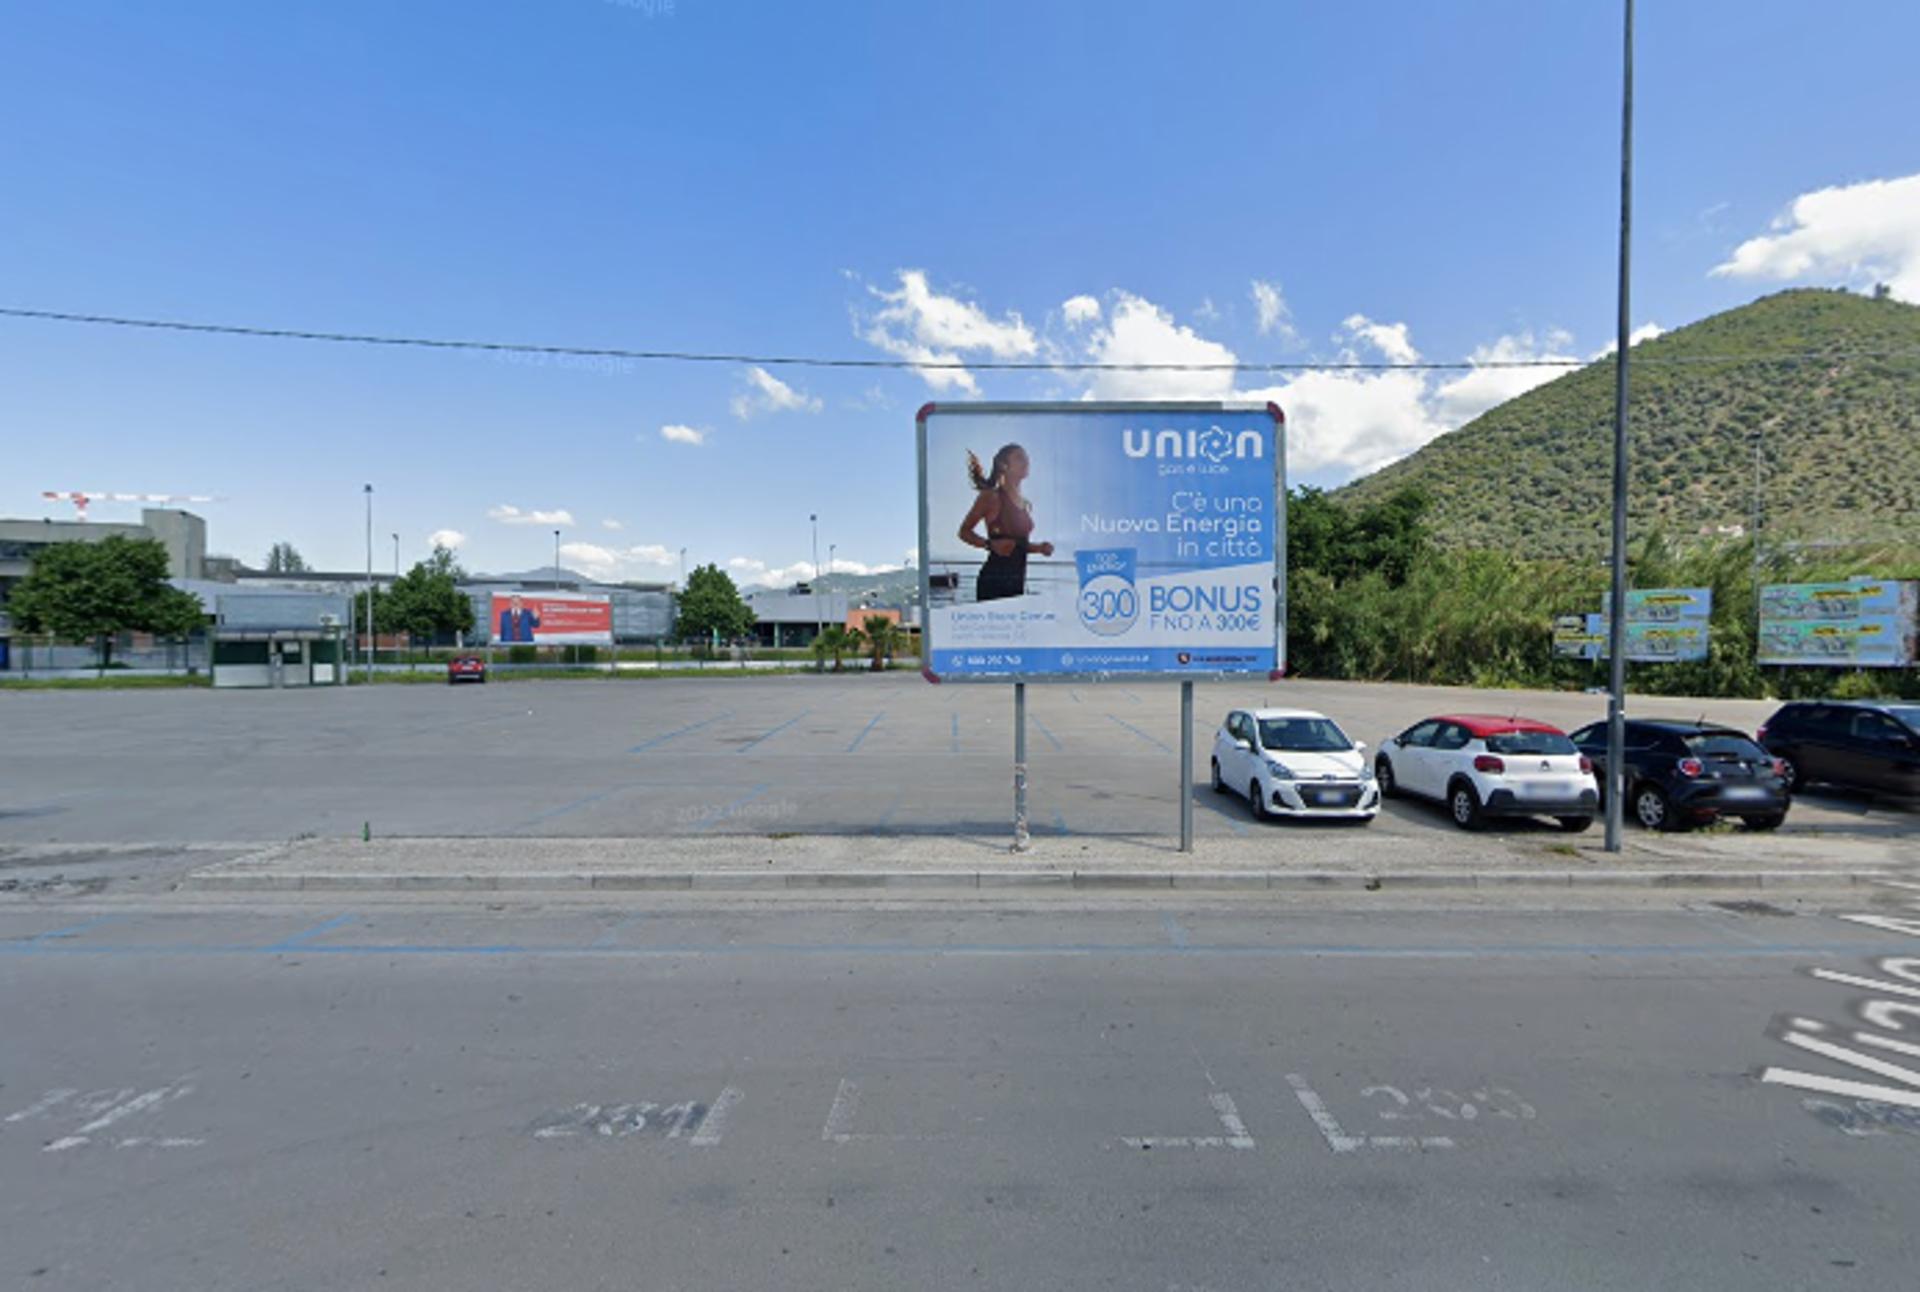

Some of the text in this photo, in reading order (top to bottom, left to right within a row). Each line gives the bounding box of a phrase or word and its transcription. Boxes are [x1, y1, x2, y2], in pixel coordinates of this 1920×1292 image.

[1172, 491, 1263, 513] C'è una
[1081, 514, 1263, 538] Nuova Energia
[1177, 537, 1199, 557] in
[1083, 588, 1135, 621] 300
[1150, 585, 1262, 613] BONUS
[1150, 614, 1261, 631] FNO A 300€
